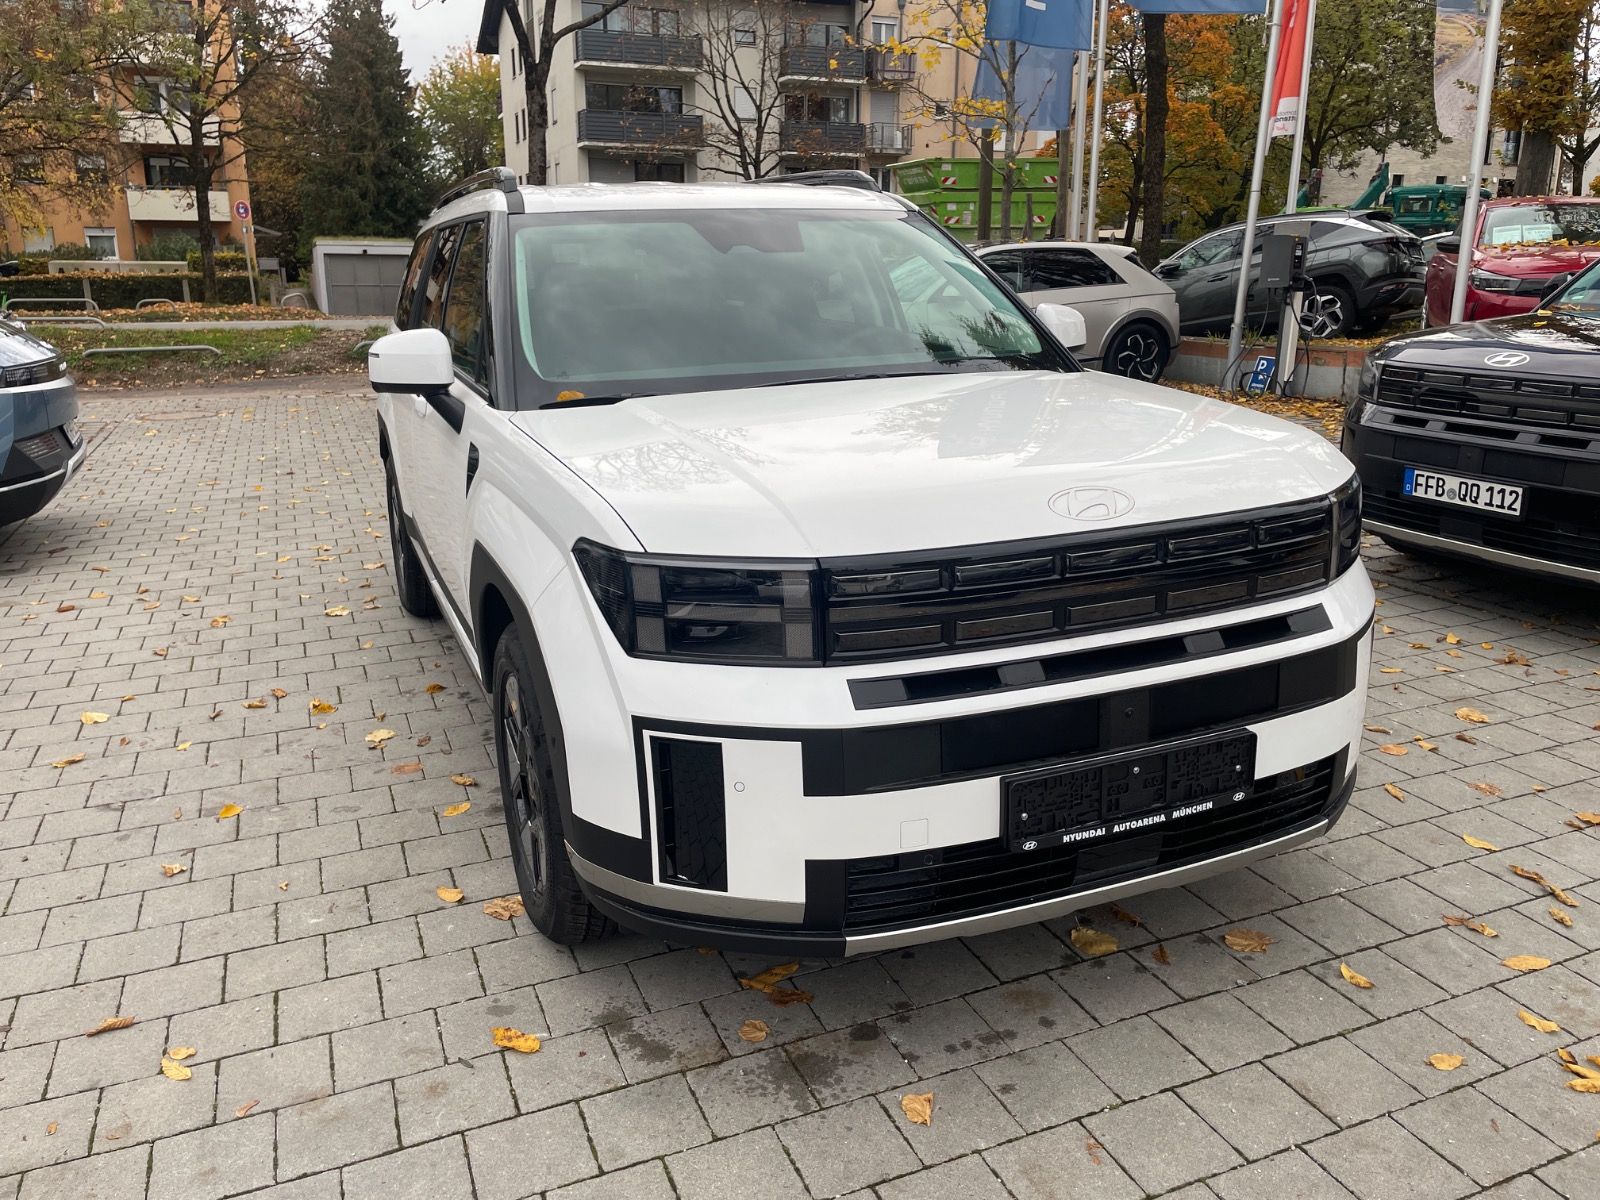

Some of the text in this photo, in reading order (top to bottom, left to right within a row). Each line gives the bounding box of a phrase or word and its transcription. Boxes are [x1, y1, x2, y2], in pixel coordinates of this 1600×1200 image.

[1257, 360, 1267, 371] P
[1413, 473, 1520, 512] FFB QQ 112
[1063, 801, 1213, 843] HYUNDAI AUTOARENA MÜNCHEN
